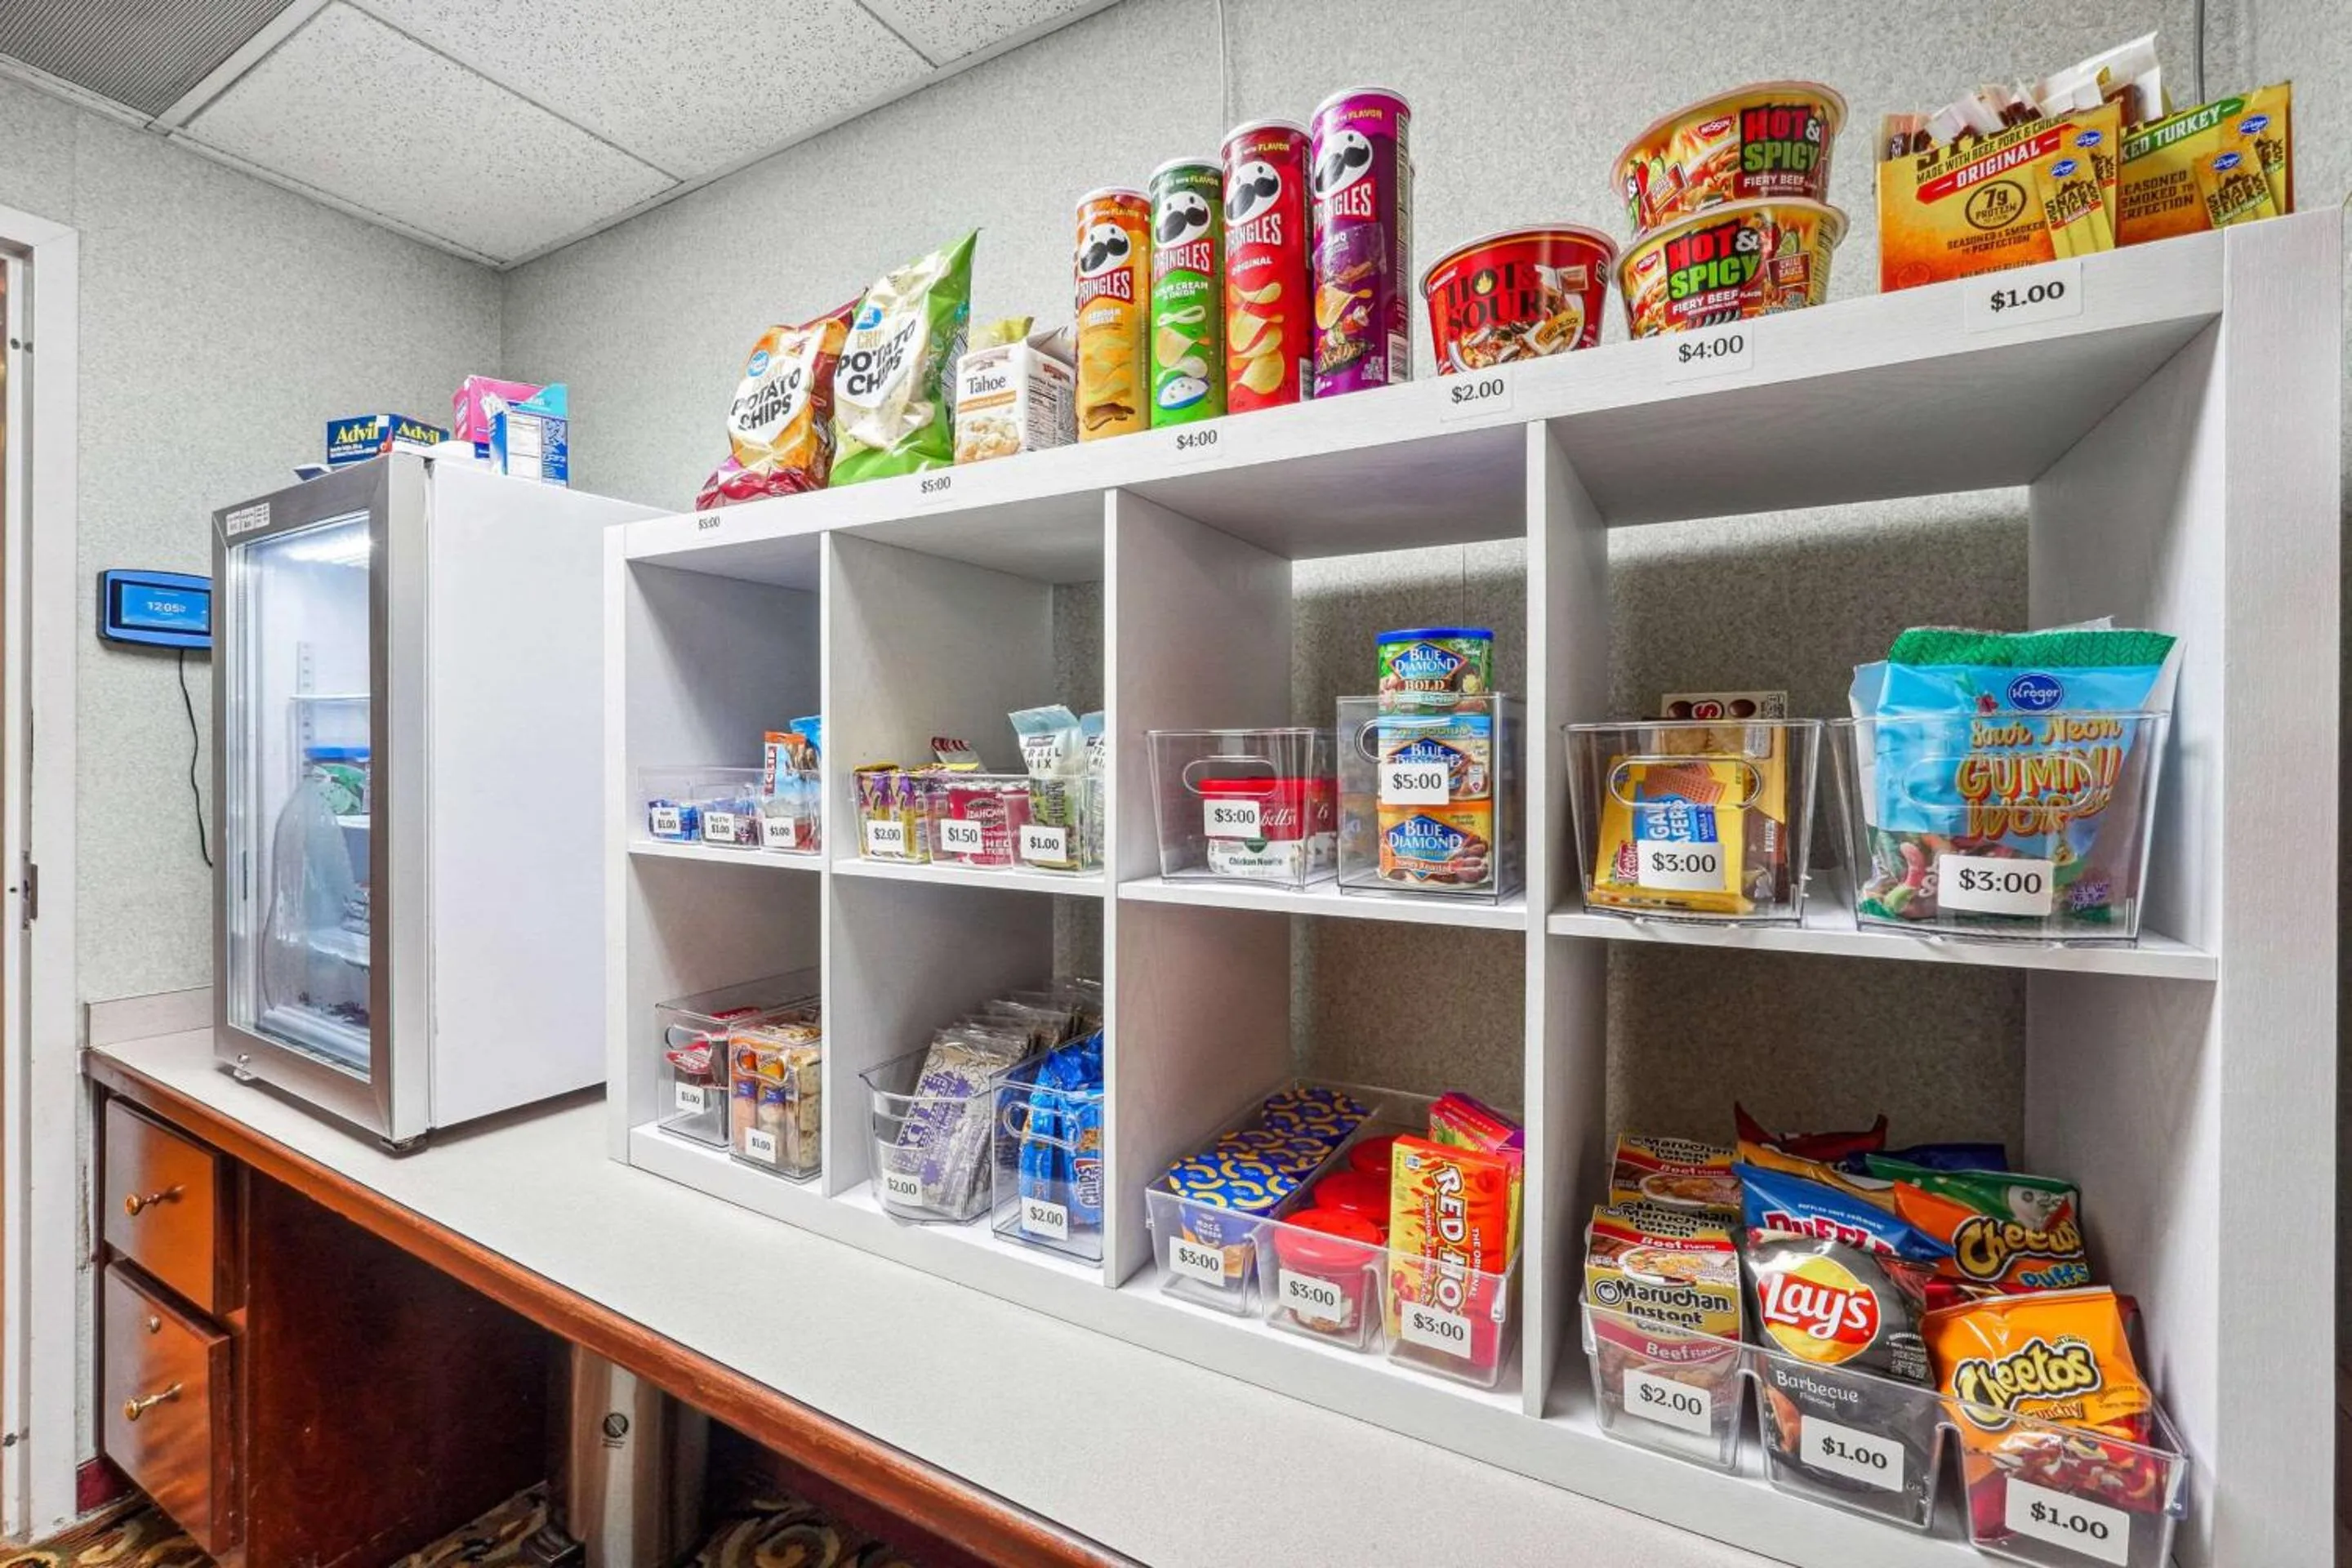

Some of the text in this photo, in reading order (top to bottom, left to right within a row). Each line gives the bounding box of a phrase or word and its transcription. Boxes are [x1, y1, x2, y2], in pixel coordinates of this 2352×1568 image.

[1744, 109, 1820, 144] HOT &
[2120, 103, 2221, 162] KED TURKEY
[1744, 140, 1820, 172] SPICY
[1915, 167, 1944, 185] MADE
[1945, 152, 1971, 172] WITH
[1998, 131, 2022, 152] PORK
[1956, 140, 2040, 189] ORIGINAL
[1743, 174, 1806, 189] FIERY BEEF
[2123, 169, 2187, 195] EASONED
[1975, 201, 2017, 220] PROTEIN
[1983, 189, 2009, 210] 7g
[2122, 194, 2194, 220] ERFECTION
[1667, 225, 1760, 271] HOT &
[1947, 231, 1997, 251] SEASONED
[2004, 220, 2047, 237] SMOKED
[1971, 234, 2031, 254] PERFECTION
[1154, 242, 1210, 282] PRINGLES
[1079, 270, 1131, 308] PRINGLES
[1668, 254, 1762, 300] SPICY
[1672, 296, 1704, 315] FIERY
[1707, 288, 1740, 304] BEEF
[1990, 280, 2065, 313] $1.00
[835, 318, 916, 378] POTATO
[1678, 334, 1744, 364] $4:00
[846, 347, 904, 396] CHIPS
[731, 367, 801, 416] POTATO
[967, 375, 1007, 395] Tahoe
[1451, 378, 1504, 404] $2.00
[737, 392, 793, 432] CHIPS
[336, 421, 380, 444] Advil
[399, 421, 440, 446] Advil
[1176, 430, 1218, 451] $4:00
[920, 475, 951, 494] $5:00
[1395, 657, 1459, 672] DIAMOND
[1409, 648, 1442, 662] BLUE
[1404, 679, 1446, 692] BOLD
[2010, 679, 2061, 706] Kroger
[1411, 744, 1445, 757] BLUE
[1392, 773, 1442, 790] $5:00
[1214, 808, 1256, 825] $3:00
[1259, 807, 1297, 827] bell's
[1405, 819, 1443, 837] BLUE
[1668, 800, 1691, 843] AFERS
[947, 827, 978, 843] $1.50
[1029, 836, 1060, 851] $1.00
[1389, 831, 1463, 849] DIAMOND
[1228, 857, 1257, 866] Chicken
[1651, 851, 1717, 874] $3:00
[1958, 866, 2042, 896] $3:00
[887, 1177, 917, 1196] $2.00
[1029, 1206, 1063, 1227] $2.00
[1433, 1165, 1467, 1244] RED
[1622, 1208, 1725, 1230] Maruchan
[1471, 1227, 1481, 1248] THE
[1640, 1236, 1683, 1250] Beef
[1178, 1246, 1219, 1272] $3:00
[1290, 1280, 1335, 1307] $3:00
[1616, 1280, 1731, 1312] Maruchan
[1764, 1272, 1872, 1340] Lay's
[1626, 1301, 1704, 1325] Instant
[1413, 1312, 1464, 1343] $3:00
[1646, 1341, 1723, 1361] Beef Flavor
[1775, 1369, 1860, 1404] Barbecue
[1957, 1345, 2094, 1423] Cheetos
[1639, 1383, 1703, 1416] $2.00
[2018, 1400, 2084, 1423] unchy
[1820, 1435, 1888, 1470] $1.00
[2029, 1500, 2109, 1540] $1.00
